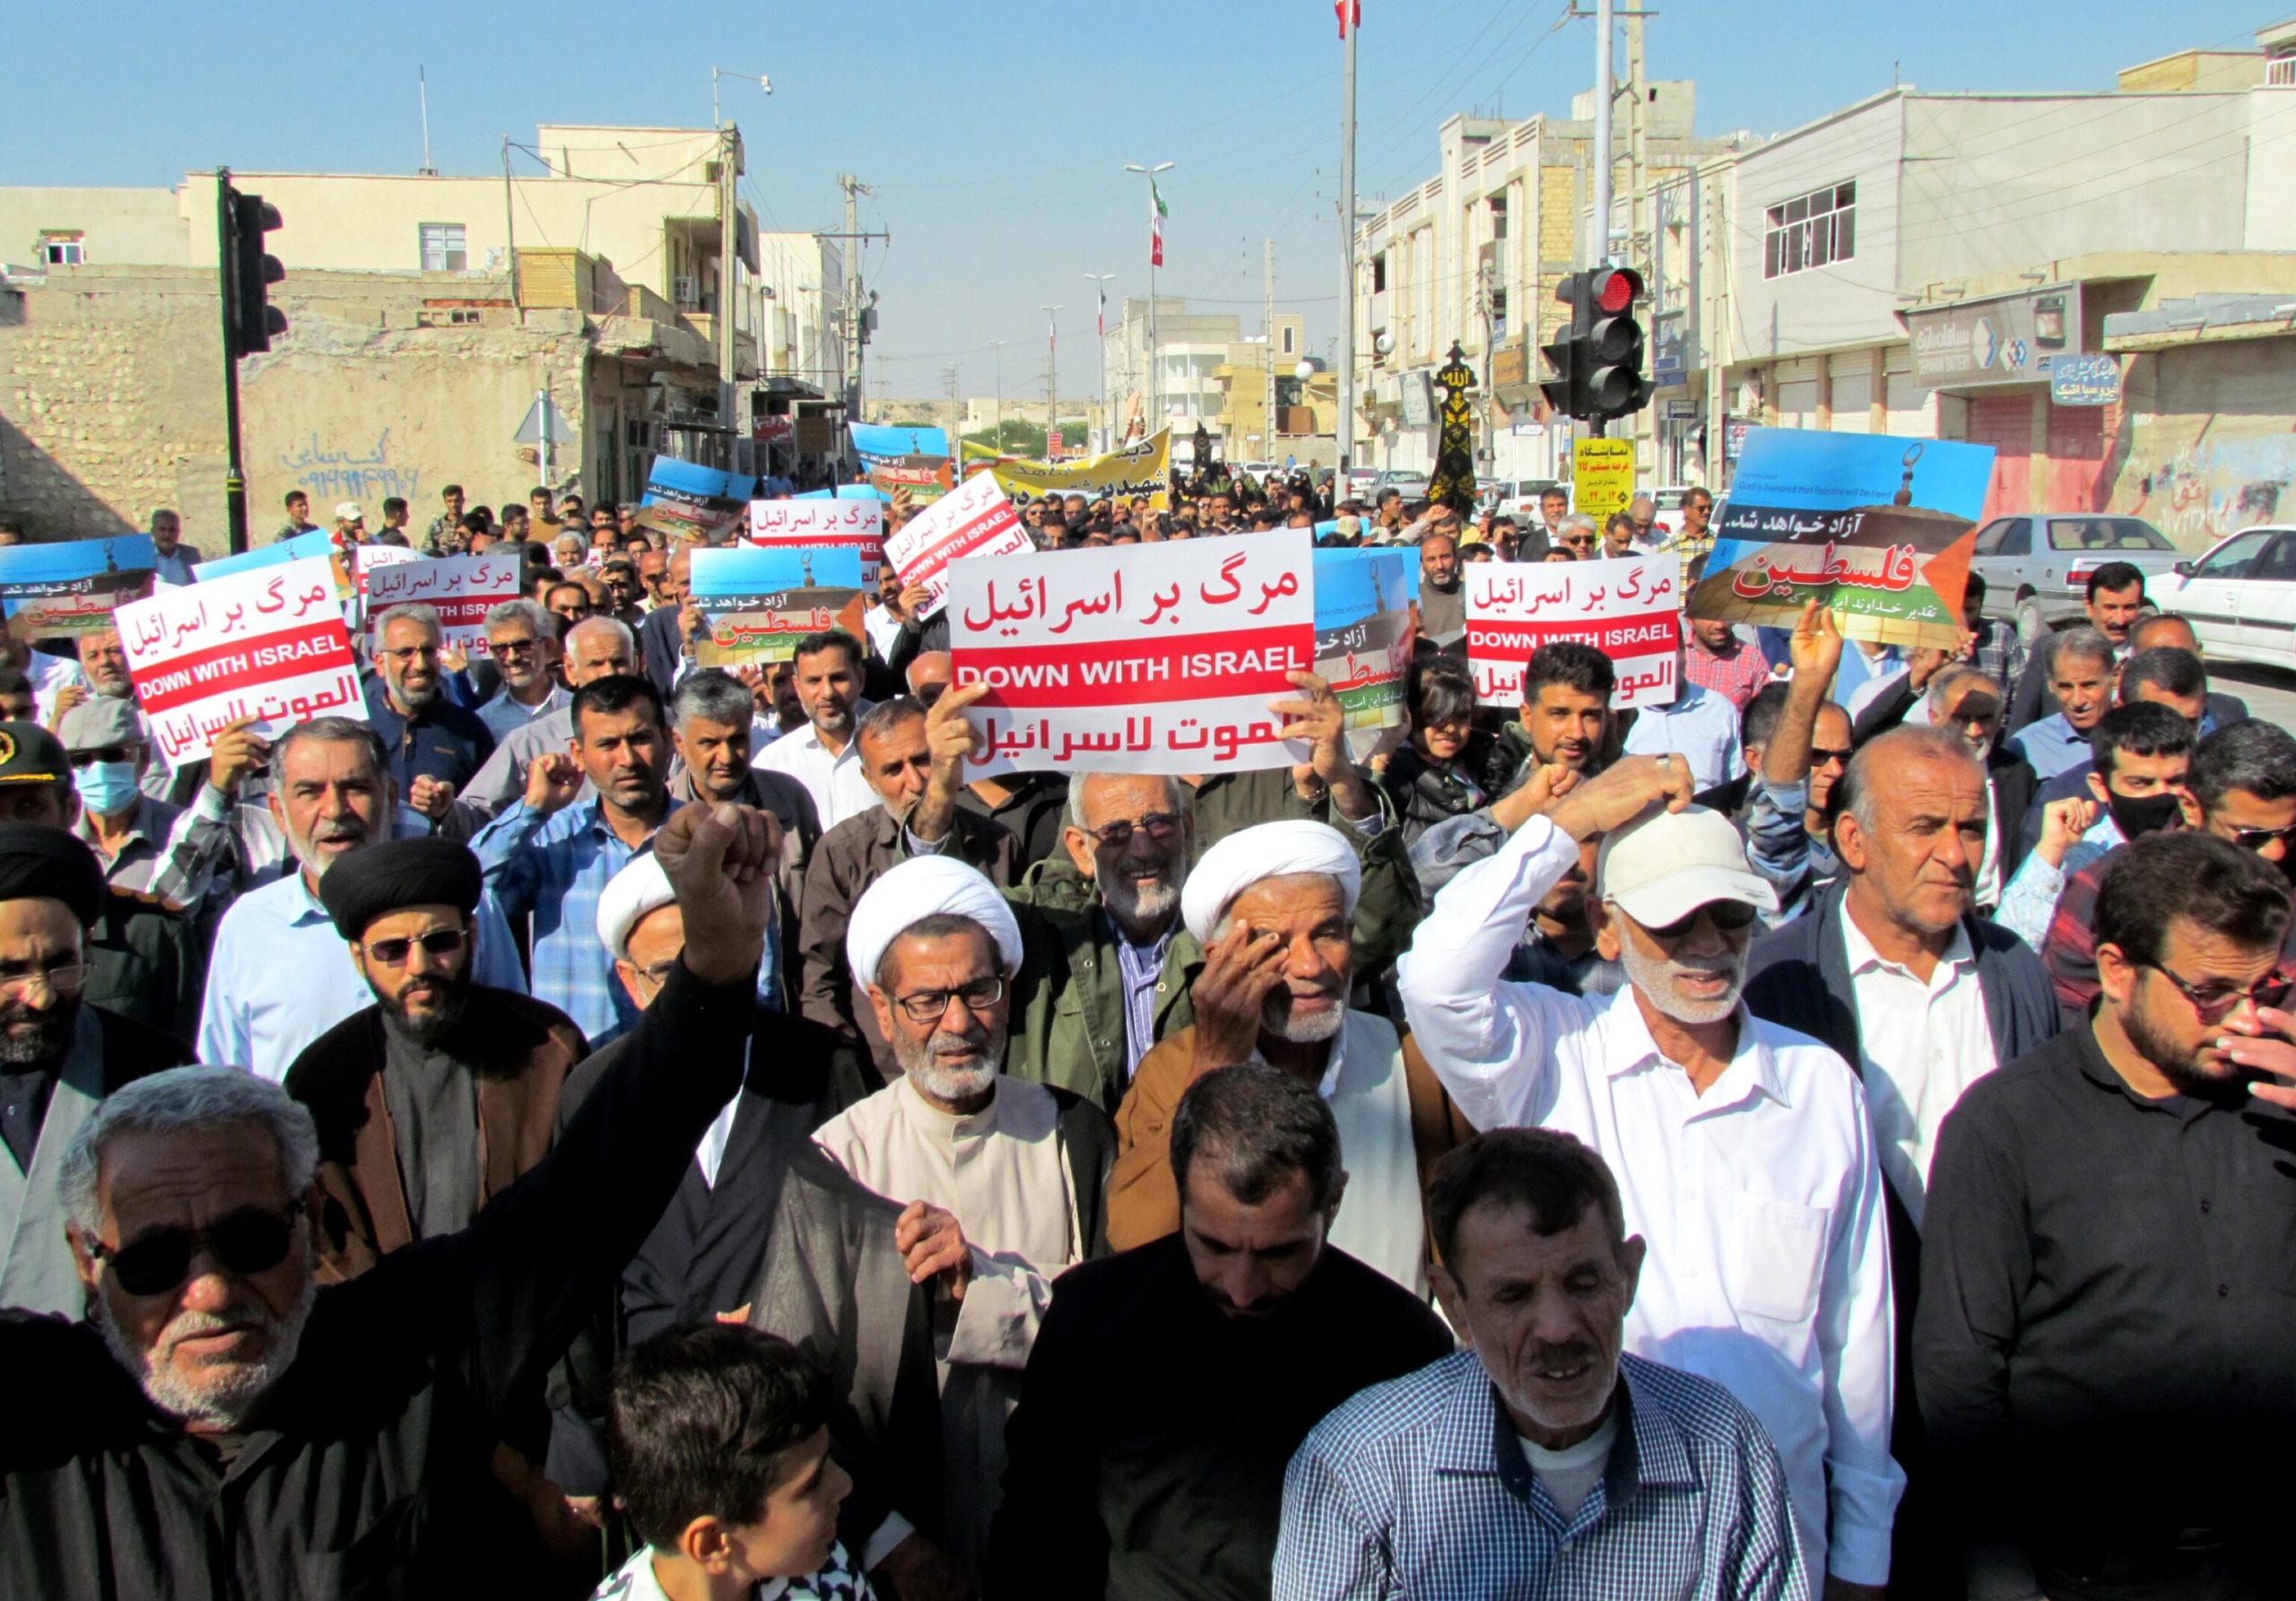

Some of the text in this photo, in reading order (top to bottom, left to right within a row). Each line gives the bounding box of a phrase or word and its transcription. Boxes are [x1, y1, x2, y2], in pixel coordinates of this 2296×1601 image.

[961, 485, 995, 512] مرگ
[1738, 481, 1756, 491] God
[1756, 483, 1763, 492] is
[1764, 483, 1796, 493] honored
[1798, 485, 1813, 494] that
[1815, 486, 1845, 496] Palestine
[1846, 487, 1859, 496] will
[1860, 488, 1869, 497] be
[756, 505, 878, 534] مرگ بر اسرائیل
[944, 510, 960, 529] بر
[1762, 513, 1825, 540] خواهد
[1828, 512, 1865, 537] آزاد
[895, 517, 939, 565] اسرائیل
[901, 509, 1012, 586] DOWN WITH ISRAEL
[993, 527, 1028, 556] الم
[372, 562, 514, 599] مرگ بر اسرائیل
[861, 566, 880, 582] الم
[1200, 550, 1300, 615] مرگ
[1732, 539, 1917, 598] فلسطین
[26, 583, 68, 596] خواهد
[69, 578, 94, 593] آزاد
[1474, 565, 1672, 614] مرگ بر اسرائیل
[436, 603, 495, 617] TH ISRA
[715, 596, 761, 611] خواهد
[764, 593, 788, 608] آزاد
[963, 569, 1123, 638] اسرائیل
[1139, 583, 1182, 626] بر
[1851, 598, 1902, 613] خداوند
[1905, 604, 1938, 620] تقدیر
[130, 575, 327, 657] مرگ بر اسرائیل
[712, 606, 833, 648] فلسطین
[1344, 624, 1367, 648] آزاد
[1470, 631, 1537, 648] DOWN
[1605, 622, 1674, 647] ISRAEL
[138, 666, 193, 700] DOWN
[193, 653, 248, 684] WITH
[254, 633, 345, 669] ISRAEL
[956, 646, 1307, 689] DOWN WITH ISRAEL
[1329, 642, 1409, 693] فلسط
[1474, 660, 1673, 701] المو ائیل
[257, 674, 360, 726] الموت
[967, 711, 1306, 767] لموت لاسرائیل
